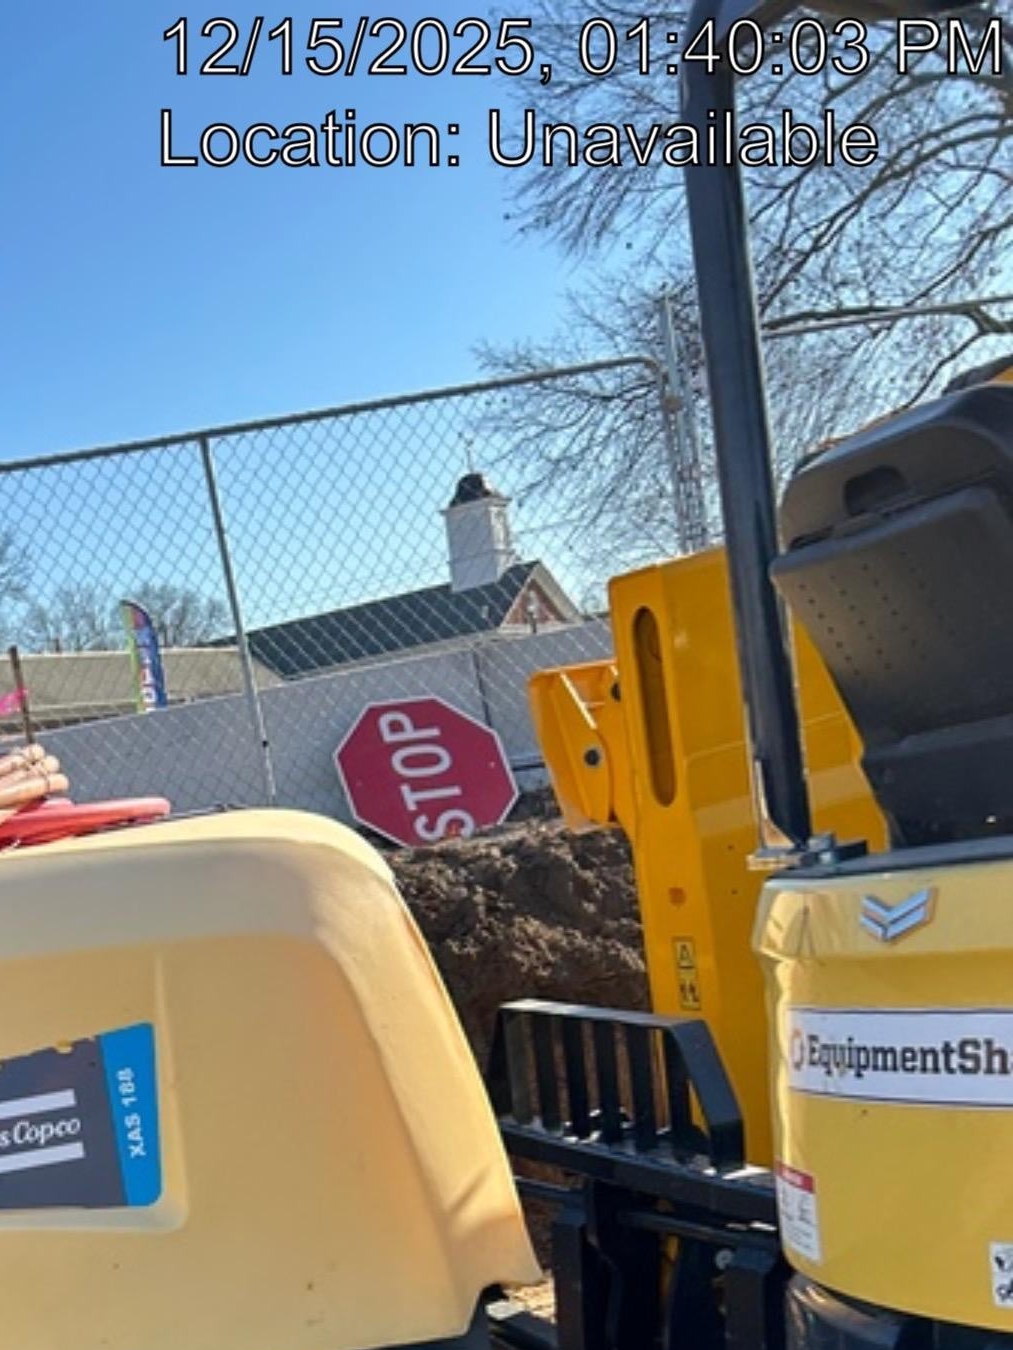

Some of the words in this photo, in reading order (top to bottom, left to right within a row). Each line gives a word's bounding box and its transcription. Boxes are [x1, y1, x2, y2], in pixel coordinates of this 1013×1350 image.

[378, 710, 477, 841] STOP
[807, 1034, 1013, 1079] EquipmentSh
[13, 1118, 81, 1147] Copco
[126, 1113, 146, 1158] XAS
